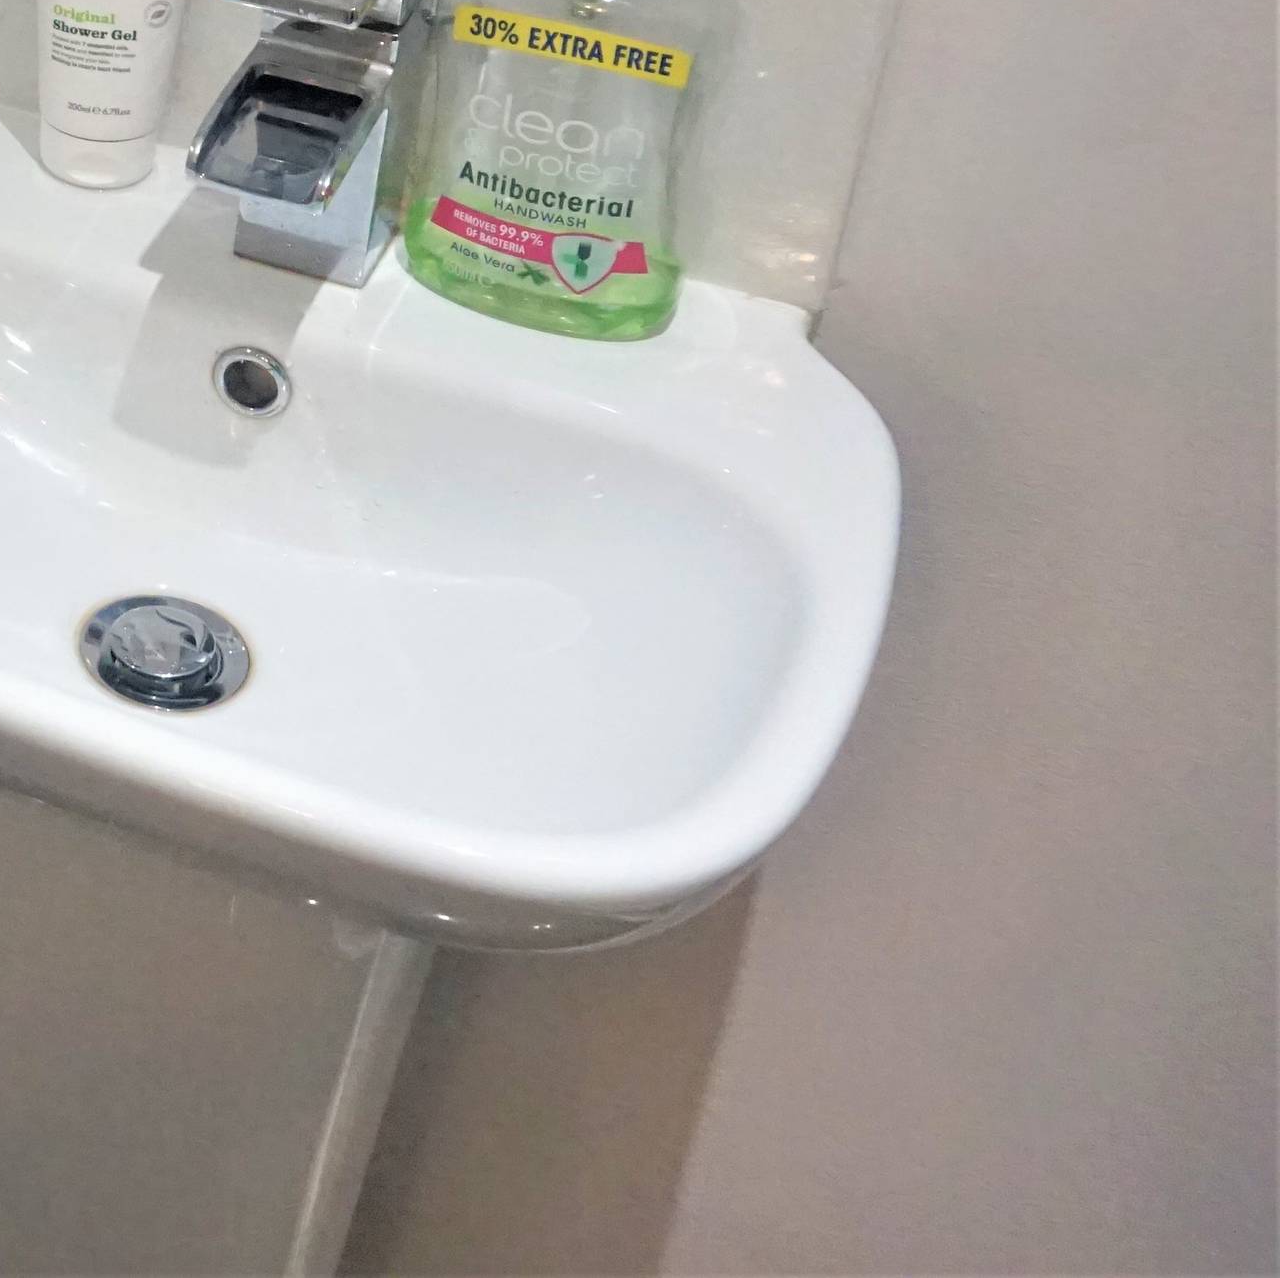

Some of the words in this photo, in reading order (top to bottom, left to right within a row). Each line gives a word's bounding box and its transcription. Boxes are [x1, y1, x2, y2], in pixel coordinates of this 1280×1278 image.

[53, 19, 108, 39] Shower
[111, 29, 137, 41] Gel
[54, 4, 115, 24] Original
[470, 14, 519, 45] 30%
[528, 27, 604, 63] EXTRA
[613, 45, 673, 77] FREE
[470, 93, 645, 160] clean
[498, 145, 639, 188] protect
[459, 161, 634, 218] Antibacterial
[453, 209, 496, 233] REMOVES
[500, 224, 544, 247] 99.9%
[494, 199, 587, 229] HANDWASH
[450, 242, 479, 259] Aloe
[483, 252, 515, 273] Vera
[466, 227, 478, 237] OF
[480, 233, 525, 255] BACTERIA
